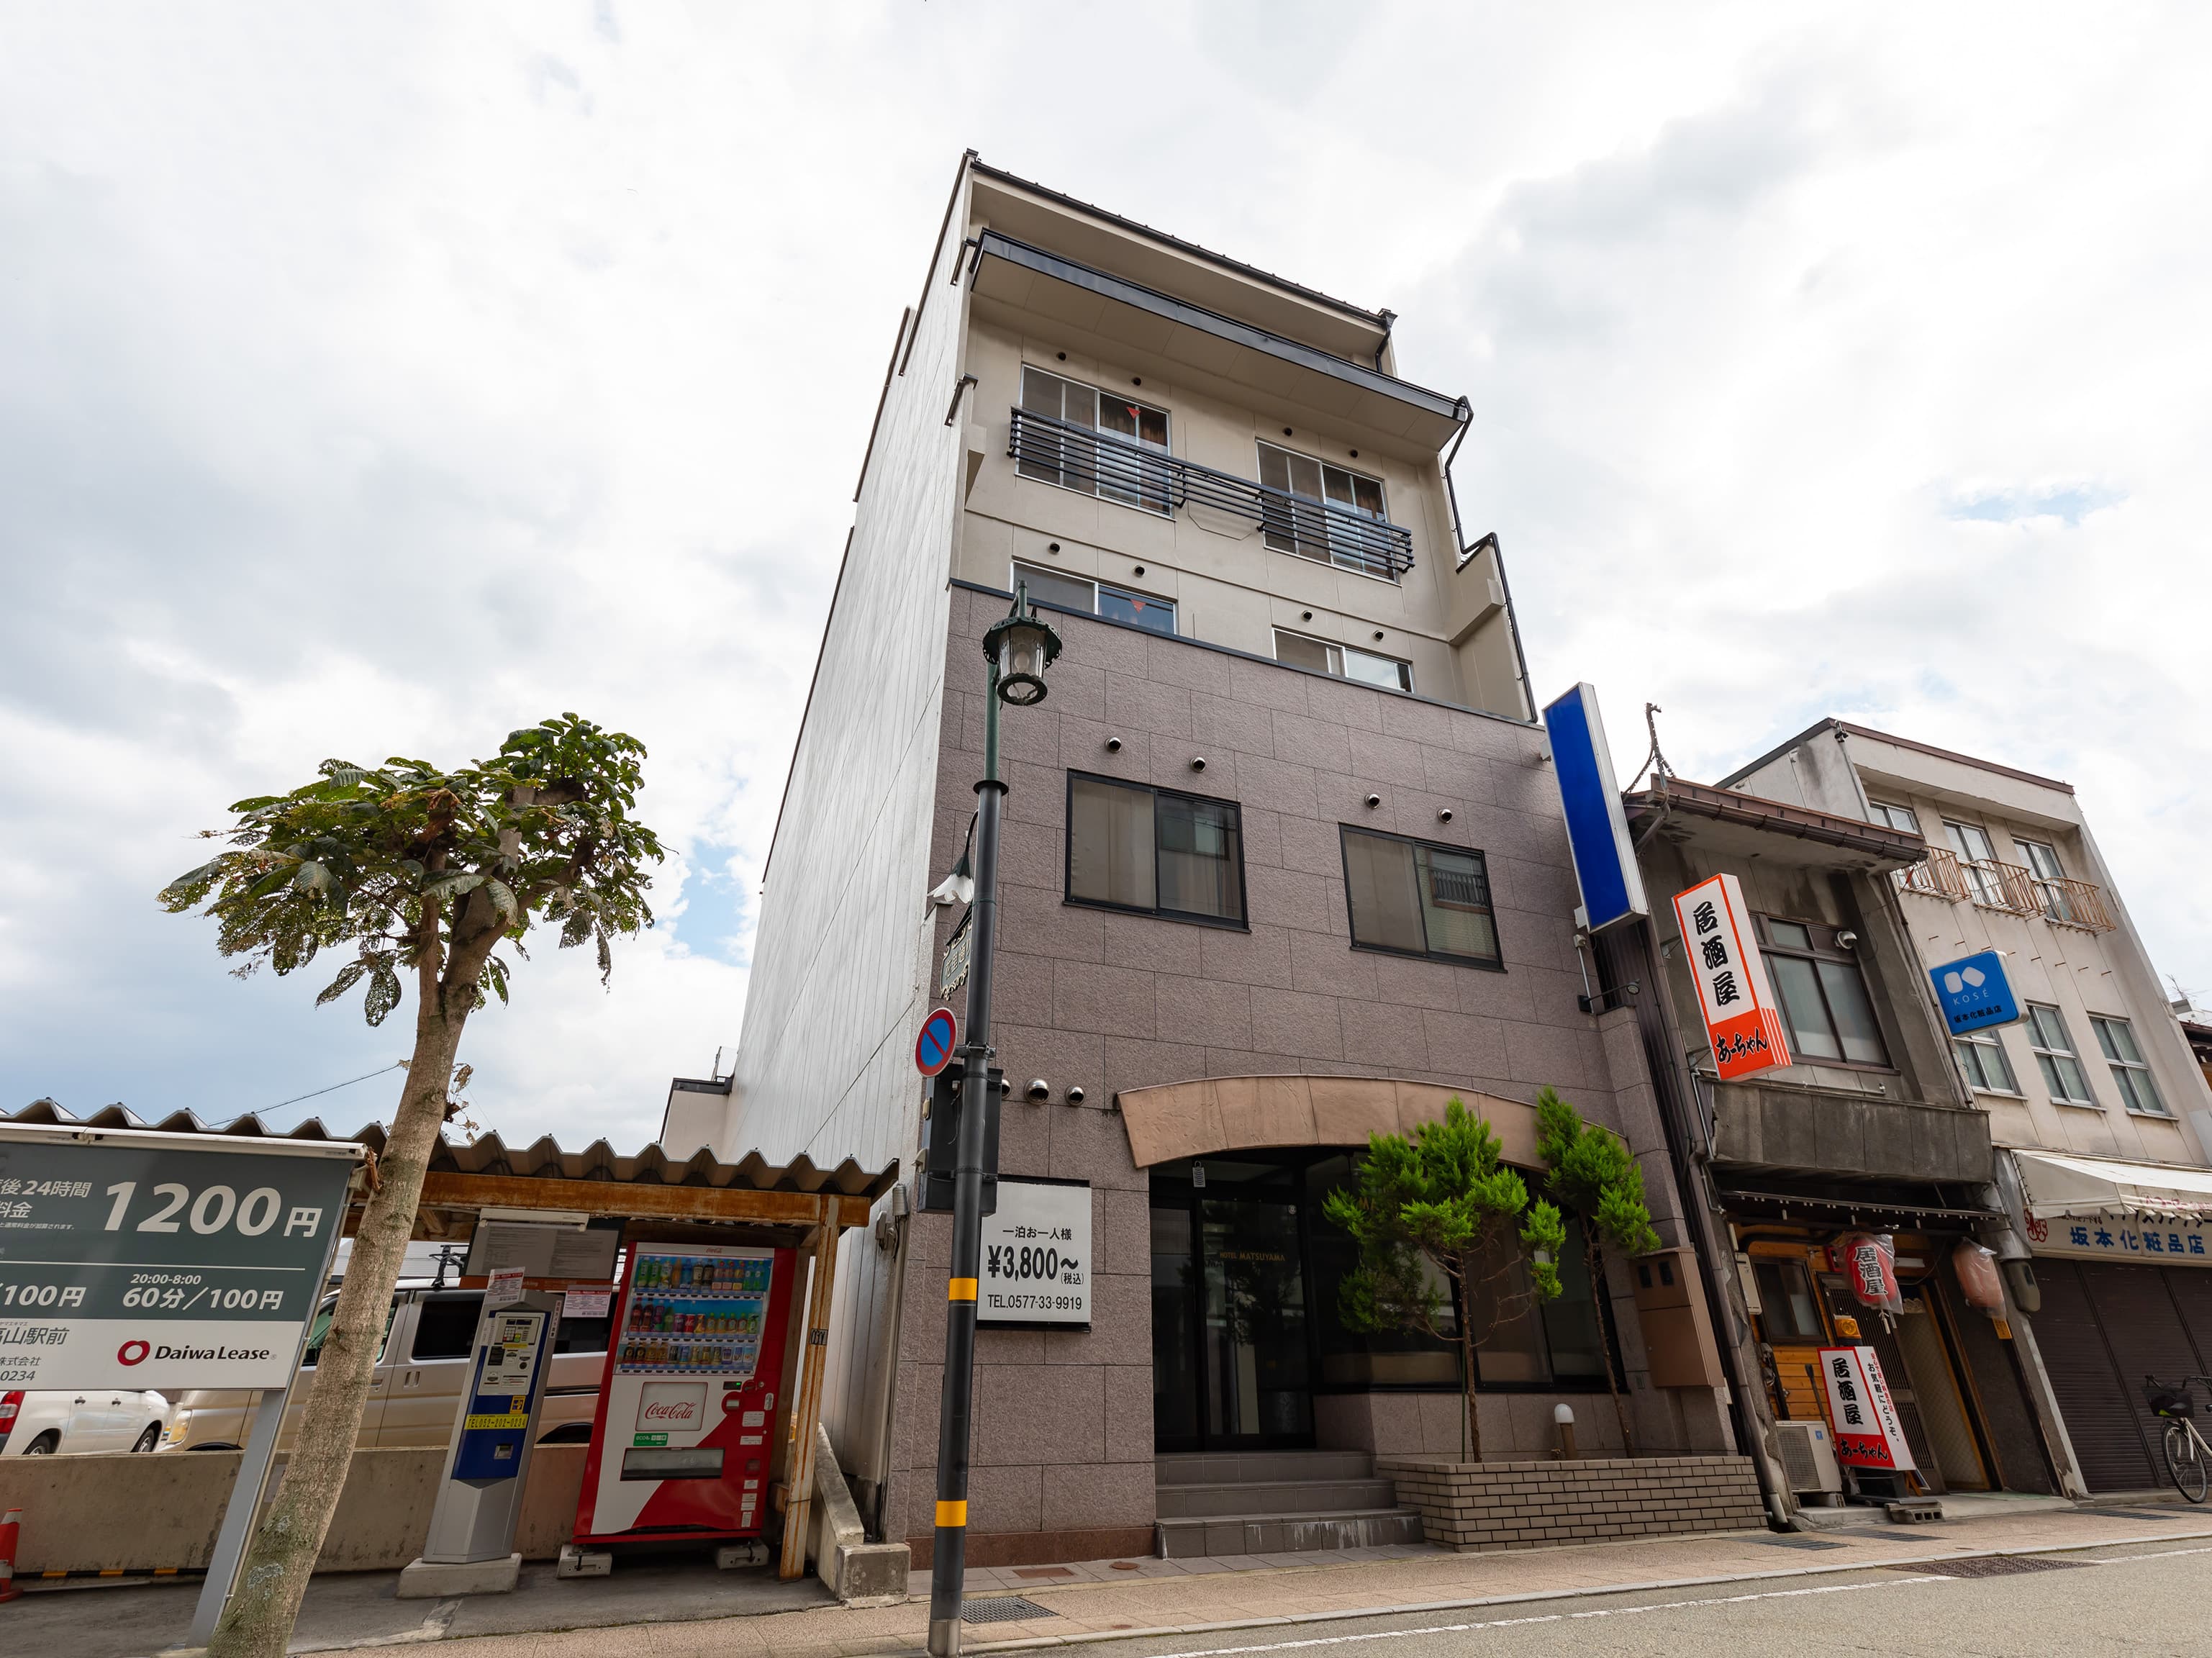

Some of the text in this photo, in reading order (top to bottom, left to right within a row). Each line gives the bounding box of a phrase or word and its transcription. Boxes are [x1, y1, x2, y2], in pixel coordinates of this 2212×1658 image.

[1693, 901, 1740, 1007] 居酒屋
[1953, 988, 1990, 1006] KOSÉ
[1715, 1027, 1767, 1064] あーちゃん
[0, 1178, 92, 1197] 後24時間
[104, 1182, 322, 1237] 1200円
[1002, 1226, 1071, 1241] 一泊お一人様
[2070, 1226, 2205, 1254] 坂本化粧品店
[1239, 1252, 1285, 1261] MATSUYAMA
[130, 1274, 201, 1285] 20:00-8:00
[1854, 1246, 1888, 1295] 居酒屋
[0, 1283, 86, 1308] 100円
[1, 1371, 35, 1381] 0234
[1832, 1357, 1864, 1426] 居酒屋
[645, 1402, 697, 1419] Coca-Cola
[1840, 1438, 1888, 1460] あーちゃん
